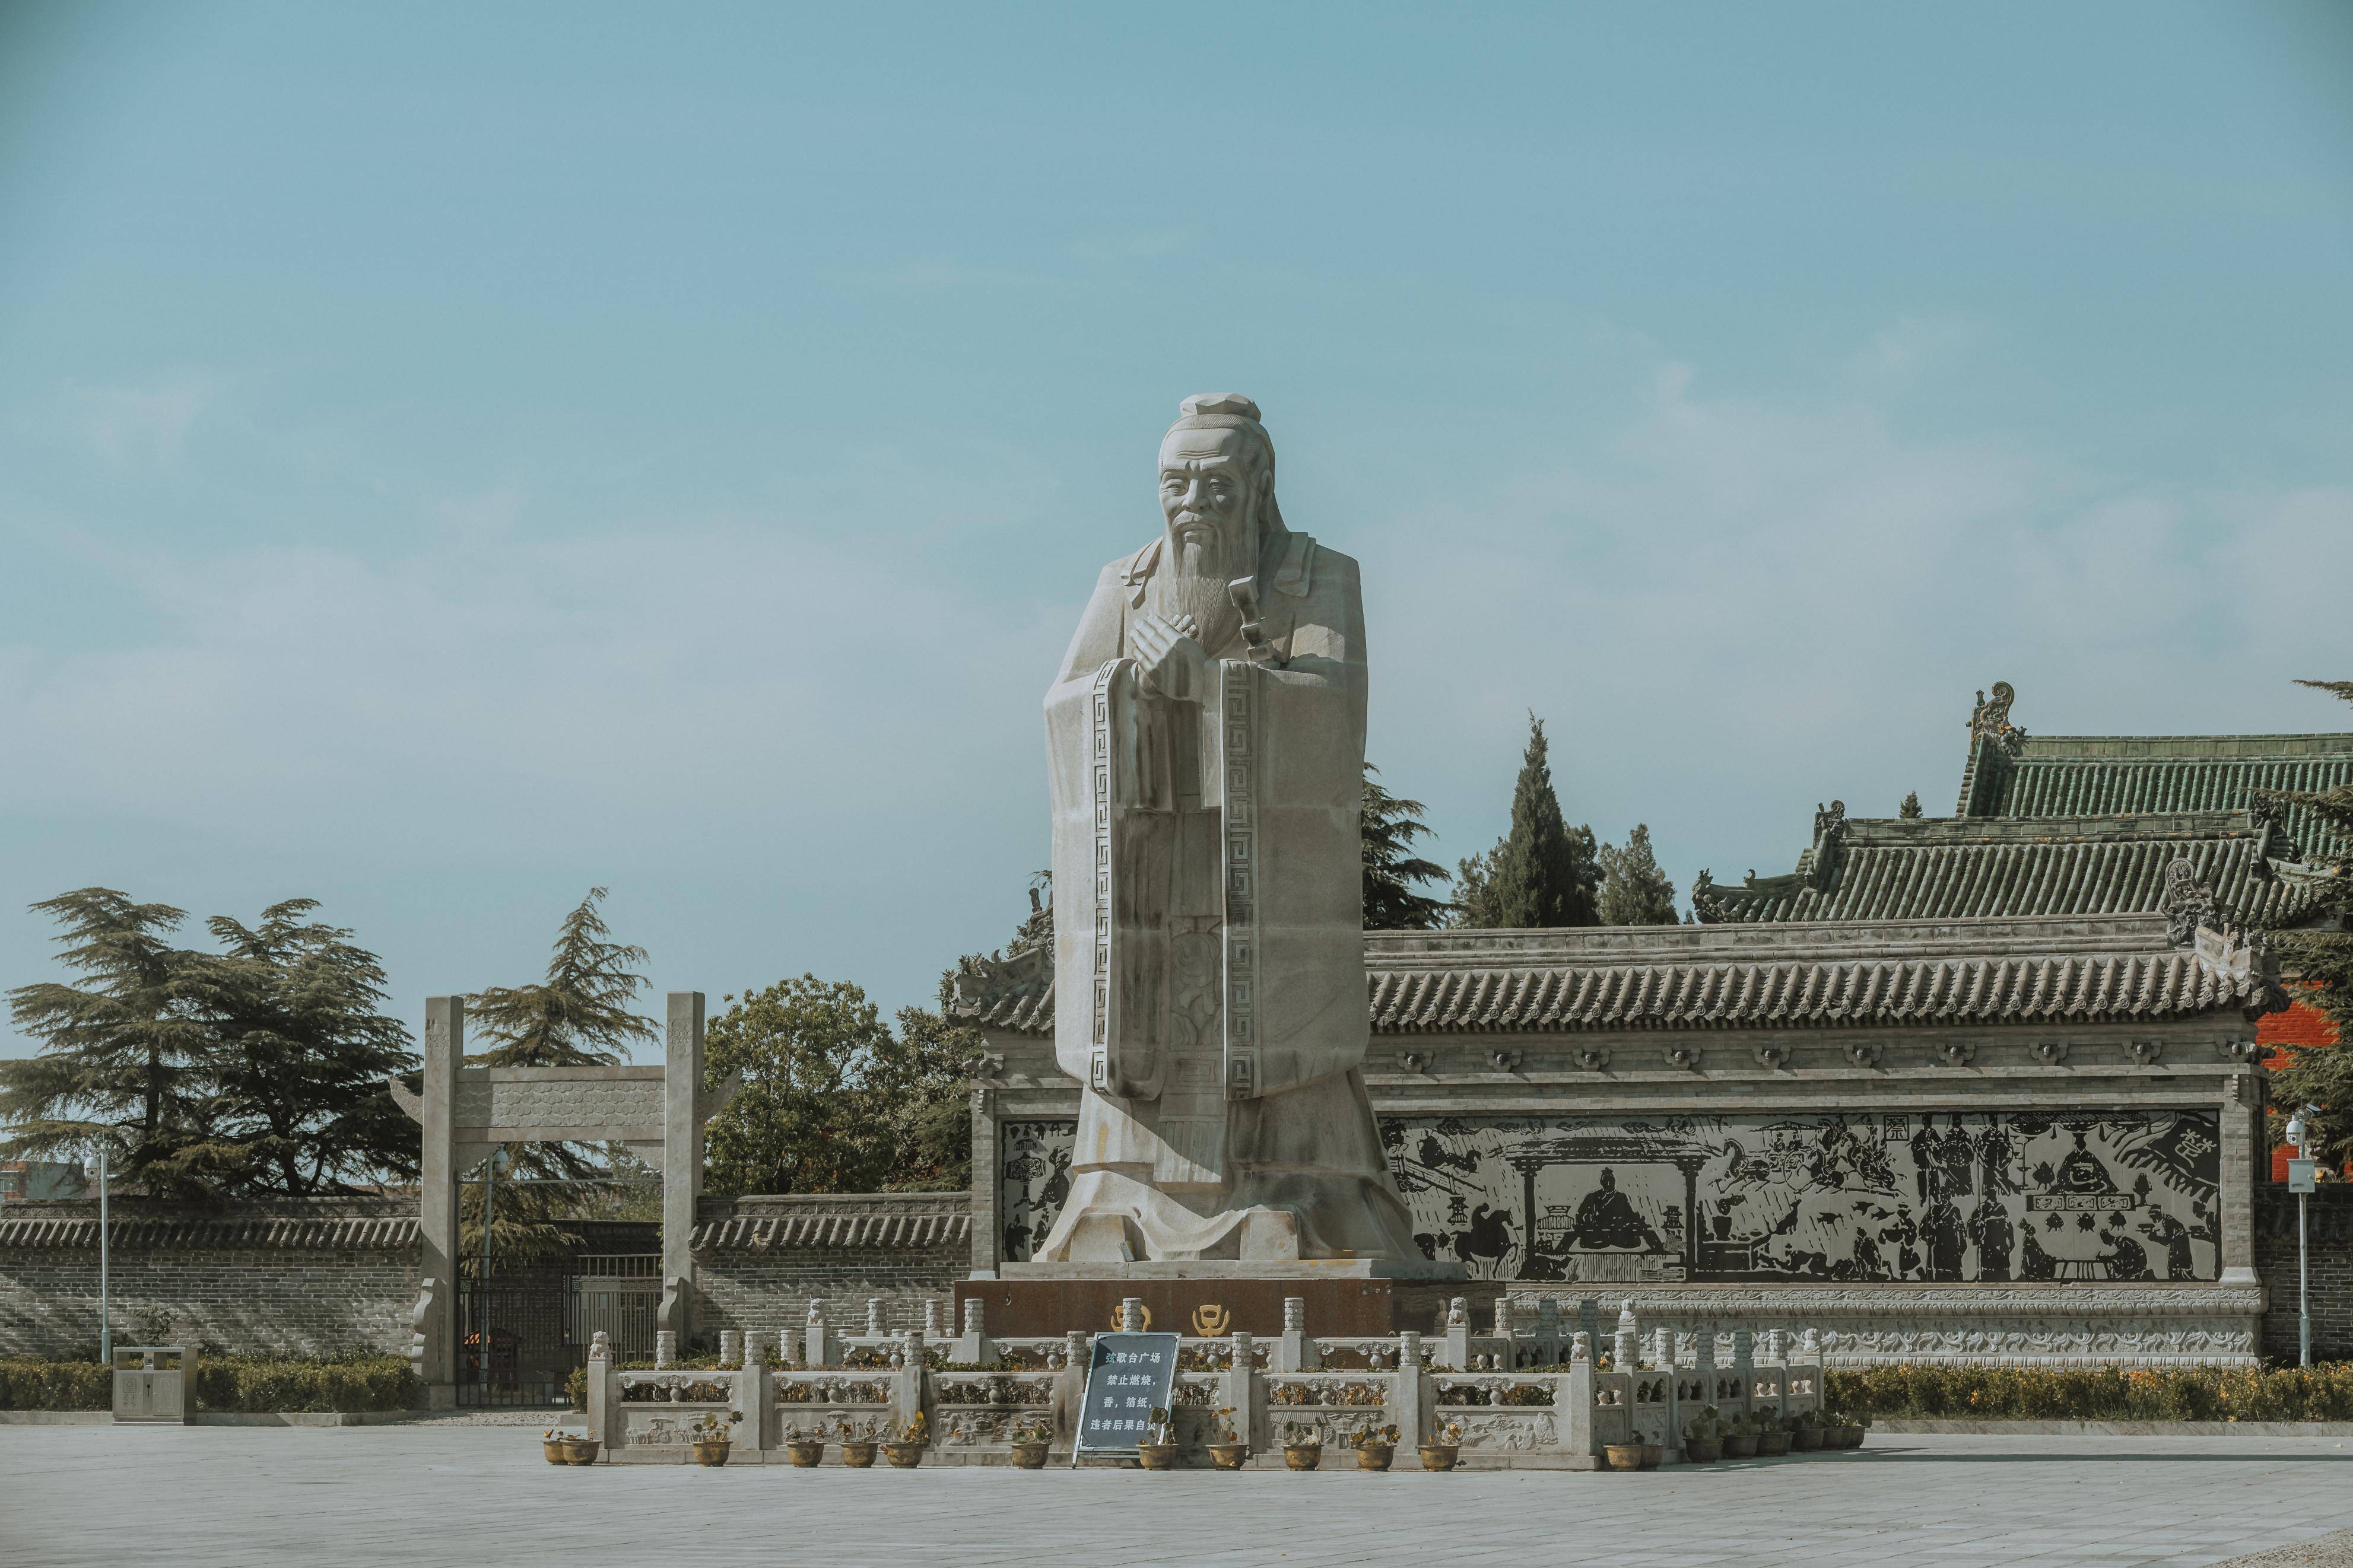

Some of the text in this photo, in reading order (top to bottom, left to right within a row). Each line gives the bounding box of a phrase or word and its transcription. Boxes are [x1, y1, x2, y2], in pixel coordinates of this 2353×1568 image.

[1106, 1352, 1161, 1363] 弦歌台广场
